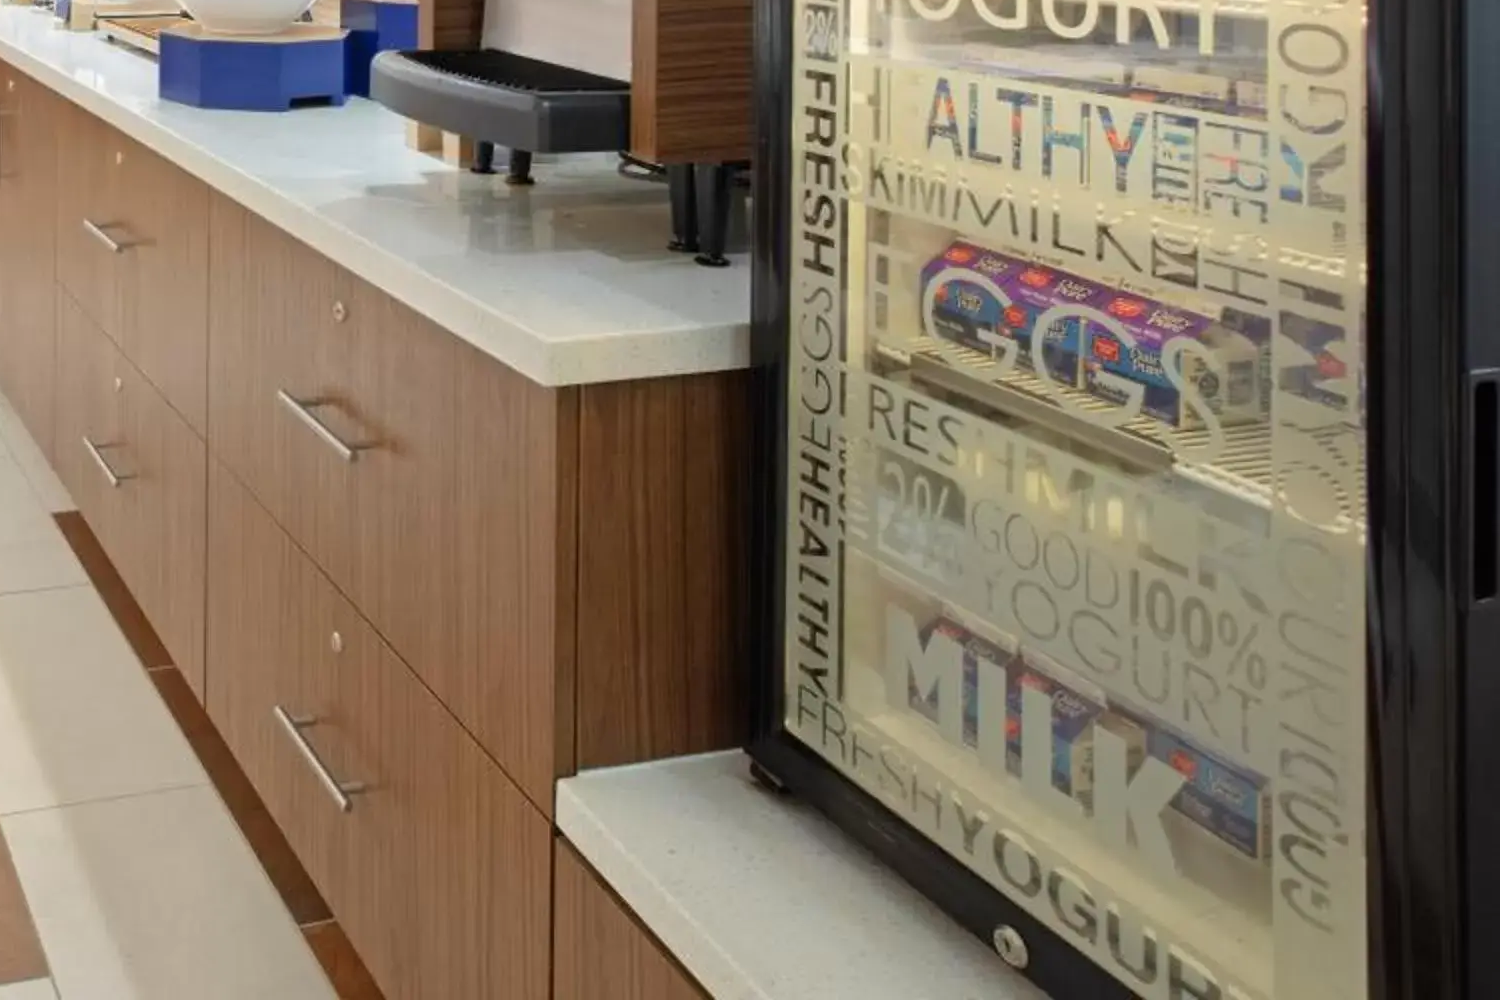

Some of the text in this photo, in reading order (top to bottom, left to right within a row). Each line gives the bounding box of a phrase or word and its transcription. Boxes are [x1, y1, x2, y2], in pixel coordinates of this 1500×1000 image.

[802, 68, 837, 277] FRESH
[797, 450, 833, 698] HEALTHY
[972, 498, 1120, 610] GOOD
[1129, 567, 1267, 692] 100%
[883, 600, 1192, 880] MILK
